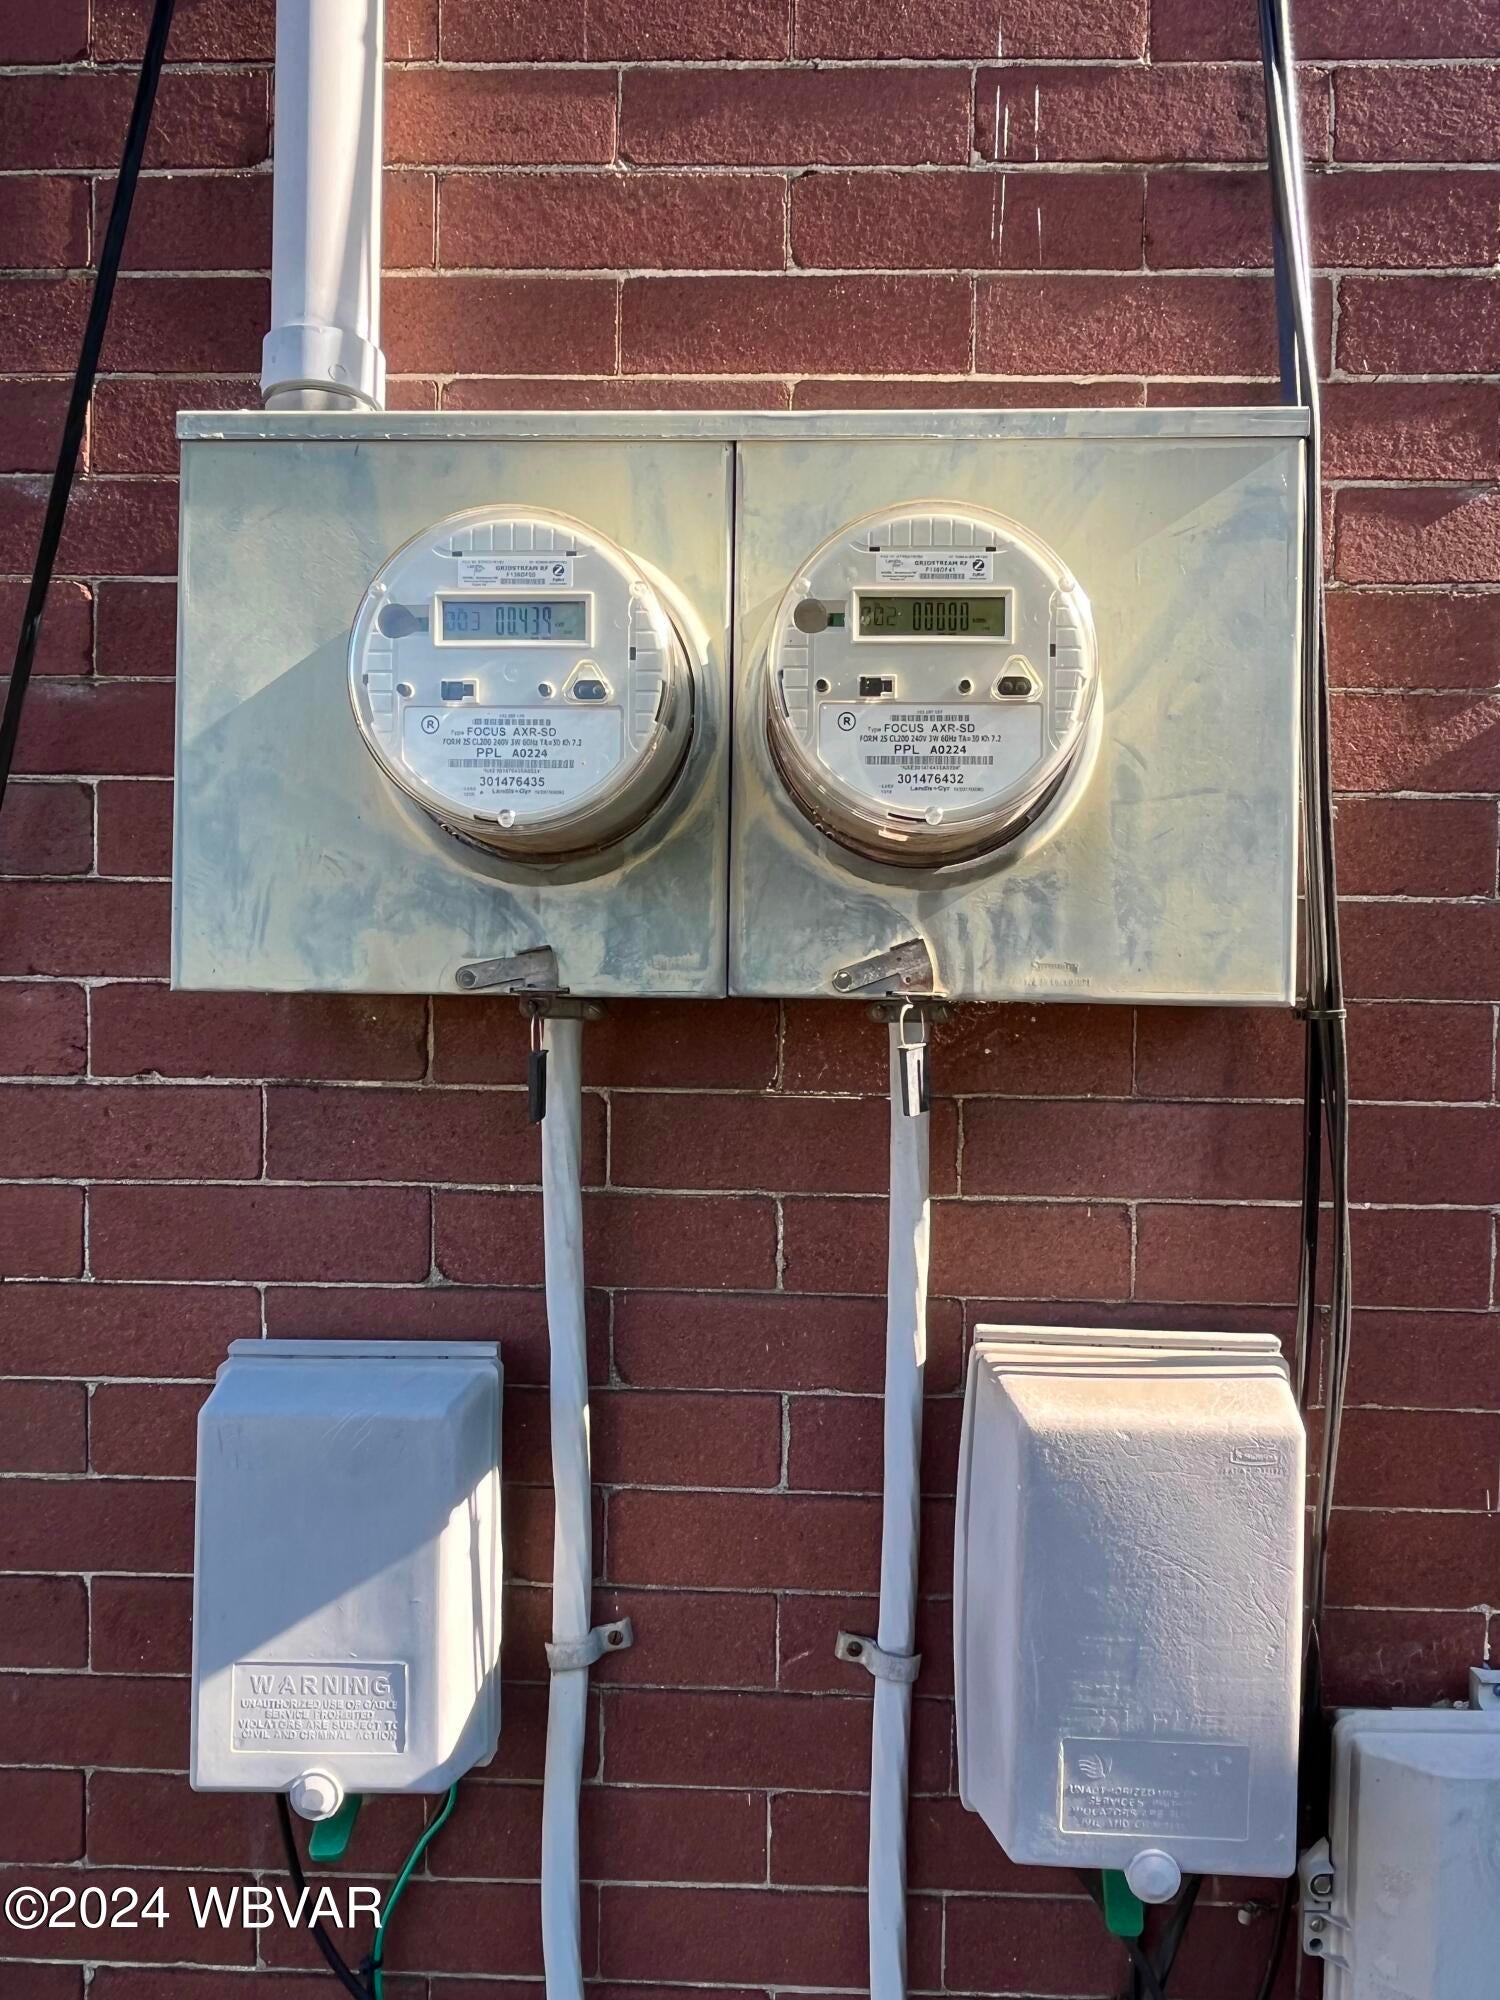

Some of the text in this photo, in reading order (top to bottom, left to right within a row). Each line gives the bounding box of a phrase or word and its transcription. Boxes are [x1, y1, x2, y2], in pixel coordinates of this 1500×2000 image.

[912, 602, 969, 631] 00000
[467, 726, 506, 736] FOCUS
[513, 727, 557, 737] AXR-SD
[884, 723, 924, 733] FOCUS
[931, 723, 975, 733] AXR-SD
[442, 738, 461, 746] FORM
[463, 738, 471, 746] 2S
[472, 738, 492, 746] CL200
[493, 738, 509, 746] 240V
[511, 738, 520, 746] 3W
[860, 734, 878, 743] FORM
[880, 734, 888, 743] 2S
[889, 734, 910, 743] CL200
[911, 734, 927, 743] 240V
[929, 734, 939, 743] 3W
[941, 734, 957, 743] 60Hz
[476, 748, 548, 758] PPL A0224
[894, 744, 967, 755] PPL A0224
[479, 776, 545, 787] 301476435
[897, 773, 964, 784] 301476432
[249, 1673, 392, 1696] WARNING
[240, 1698, 398, 1712] UNAUTHORIZED USE OF CABLE
[265, 1708, 310, 1720] SERVICE
[238, 1719, 398, 1732] VIOLATORS ARE SUBJECT TO
[241, 1729, 398, 1742] CIVIL AND CRIMINAL ACTION
